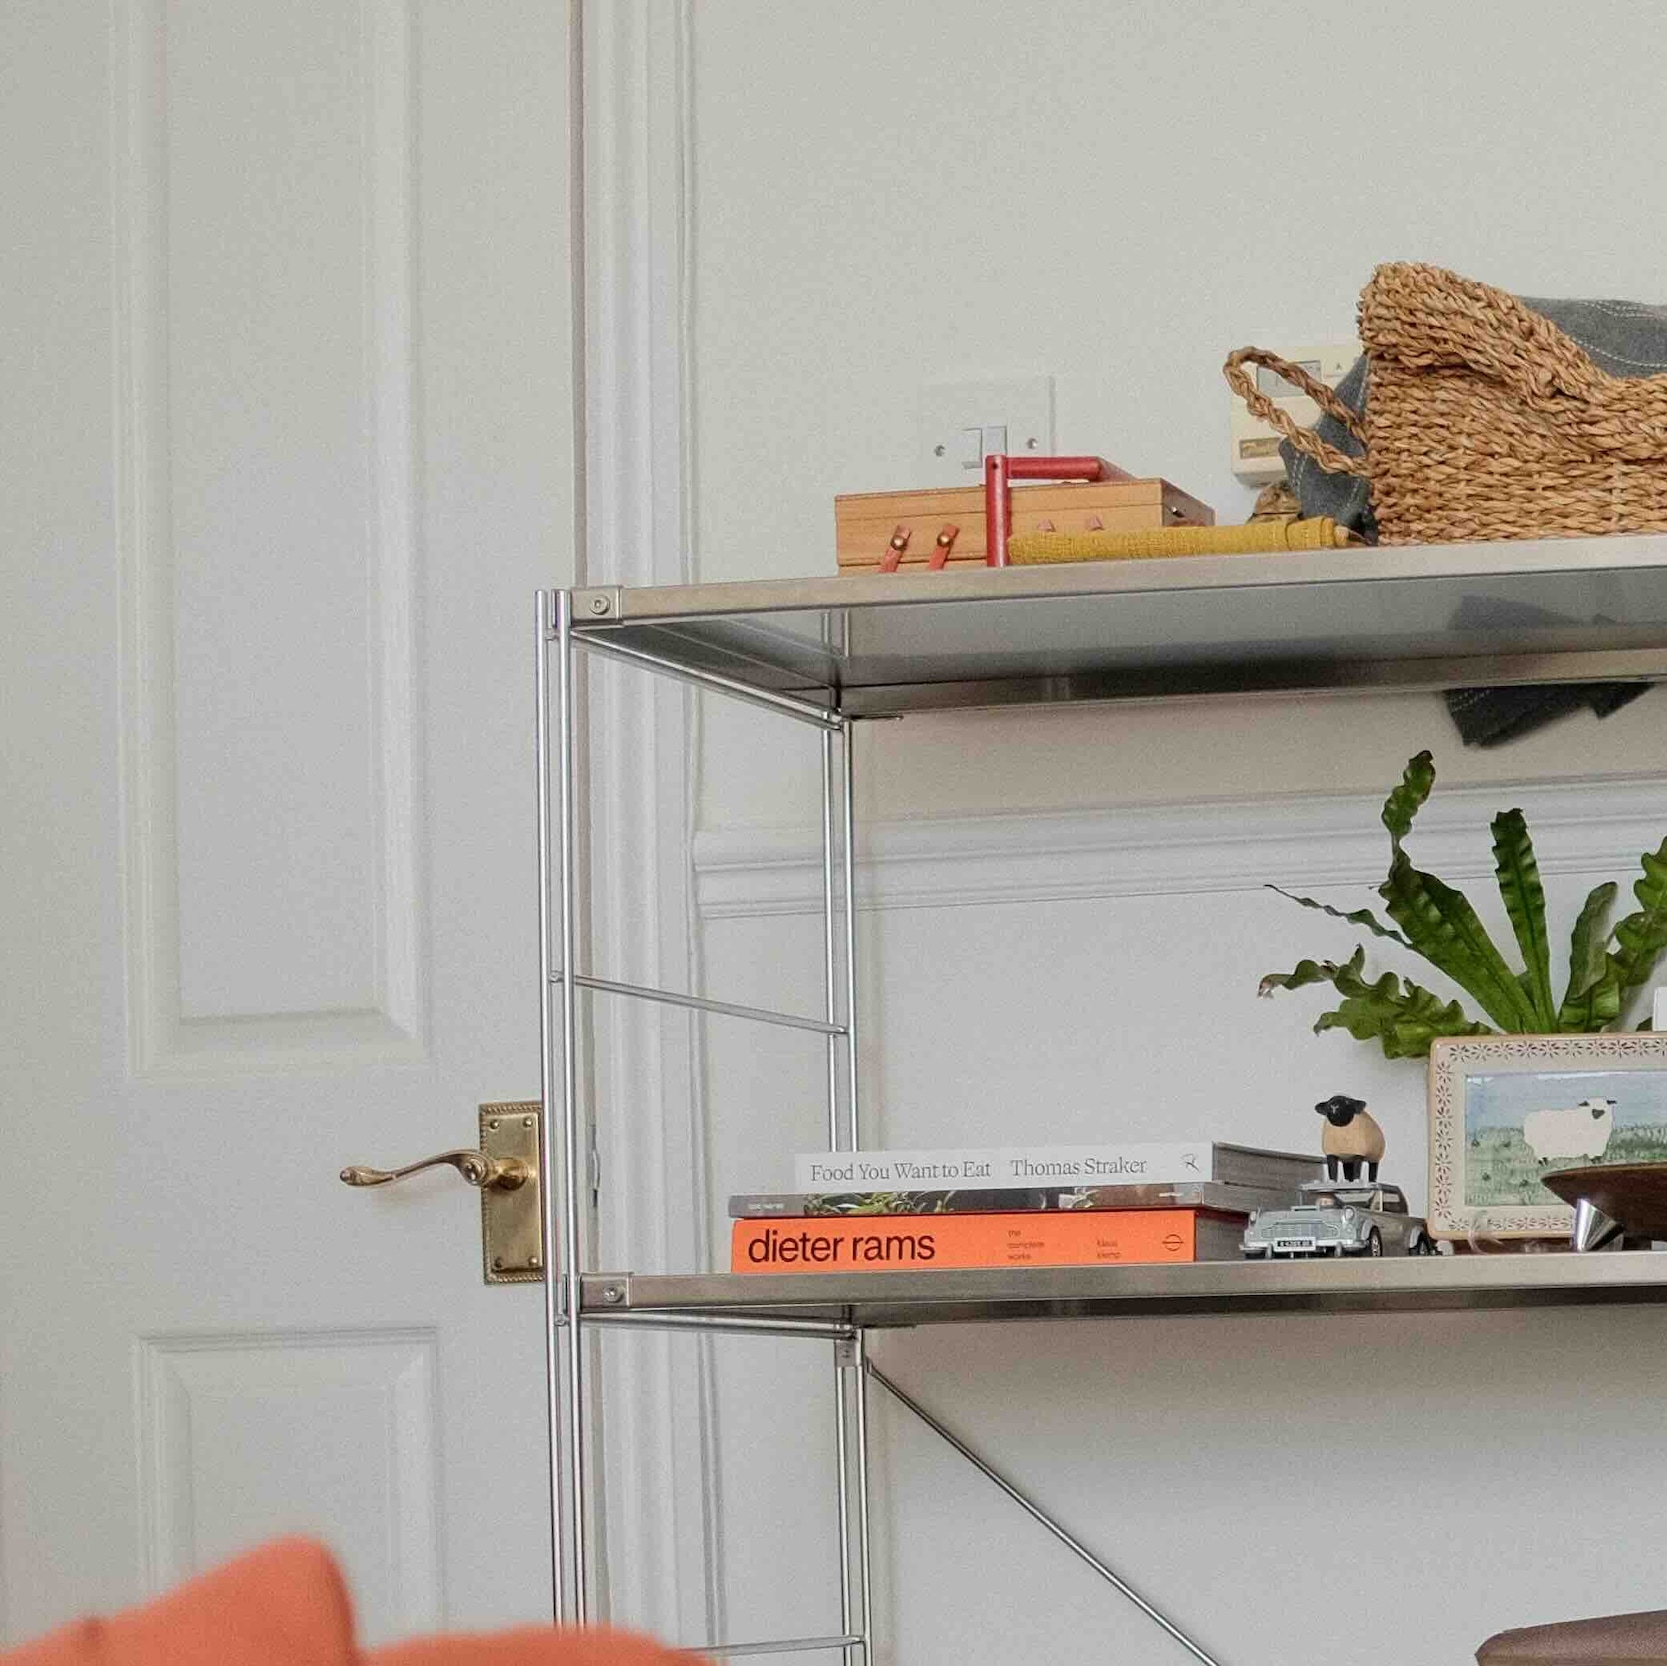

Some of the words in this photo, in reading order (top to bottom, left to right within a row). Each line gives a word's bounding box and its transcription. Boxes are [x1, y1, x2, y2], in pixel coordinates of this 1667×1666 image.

[811, 1163, 854, 1182] Food
[859, 1163, 890, 1180] You
[894, 1161, 940, 1180] Want
[943, 1163, 959, 1179] to
[963, 1160, 991, 1178] Eat
[1010, 1158, 1081, 1177] Thomas
[1084, 1156, 1148, 1175] Straker
[748, 1228, 845, 1263] dieter
[851, 1234, 936, 1262] rams
